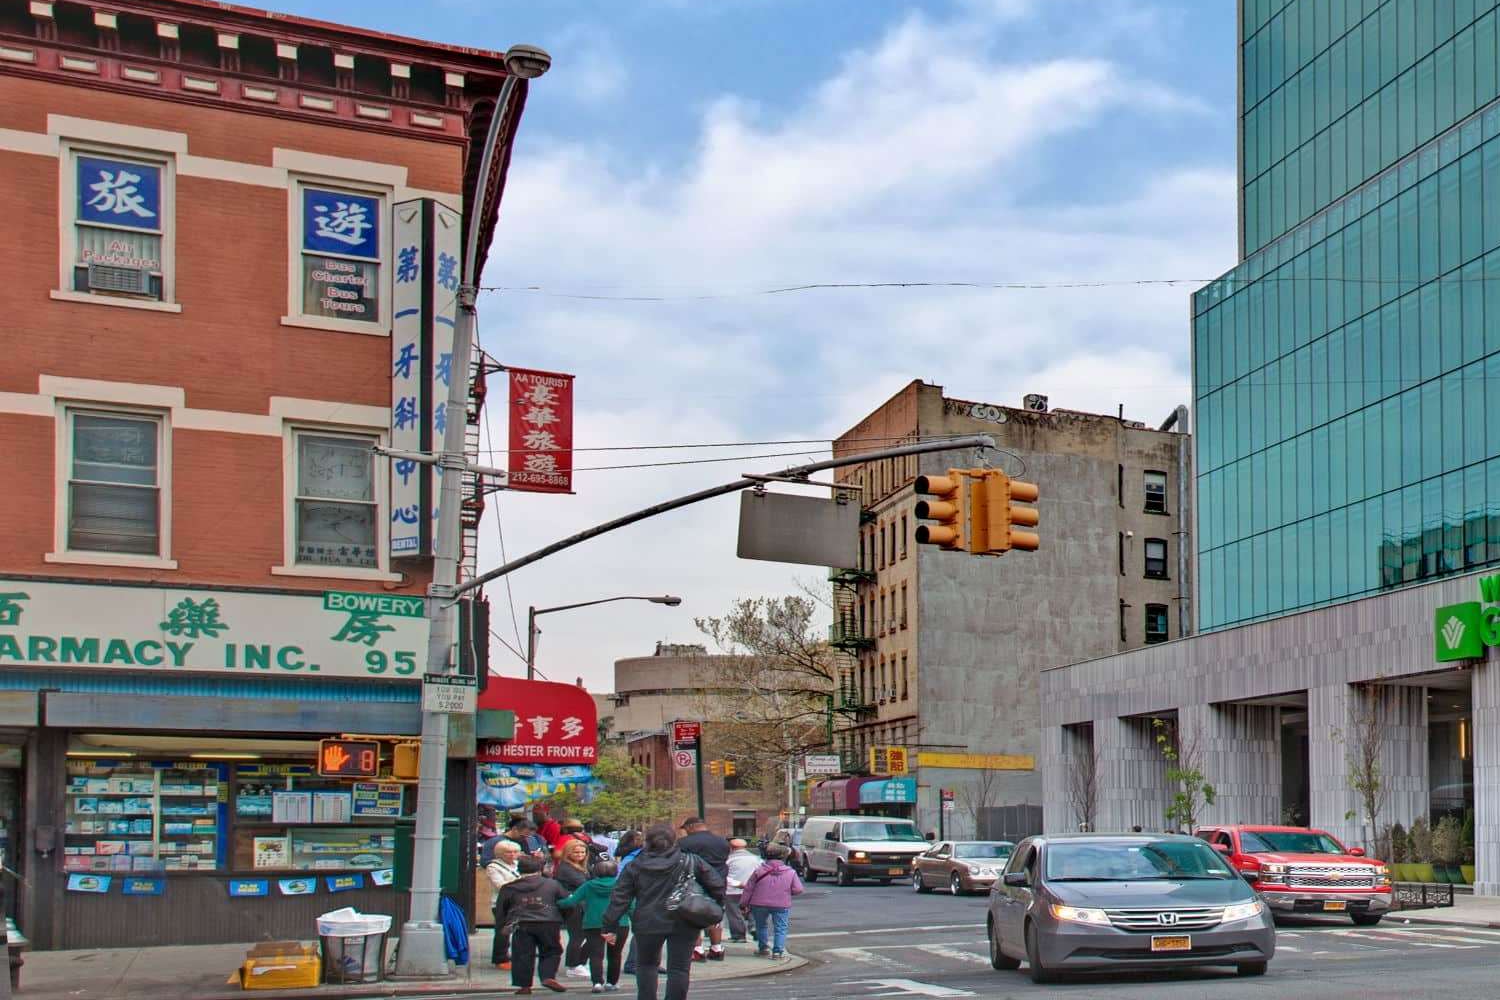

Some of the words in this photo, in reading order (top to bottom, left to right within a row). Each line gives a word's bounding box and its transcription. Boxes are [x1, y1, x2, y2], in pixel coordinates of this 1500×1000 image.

[84, 170, 156, 218] 旅
[313, 202, 373, 246] 遊
[325, 260, 356, 272] Bus
[327, 287, 358, 300] Bus
[320, 299, 366, 313] Tours
[392, 246, 420, 525] 第一牙科中心
[515, 374, 528, 384] AA
[530, 376, 569, 388] TOURIST
[327, 594, 421, 614] BOWERY
[225, 643, 320, 671] INC.
[365, 650, 416, 675] 95
[486, 744, 500, 756] 149
[503, 745, 544, 756] HESTER
[547, 746, 581, 757] FRONT
[582, 746, 595, 758] #2
